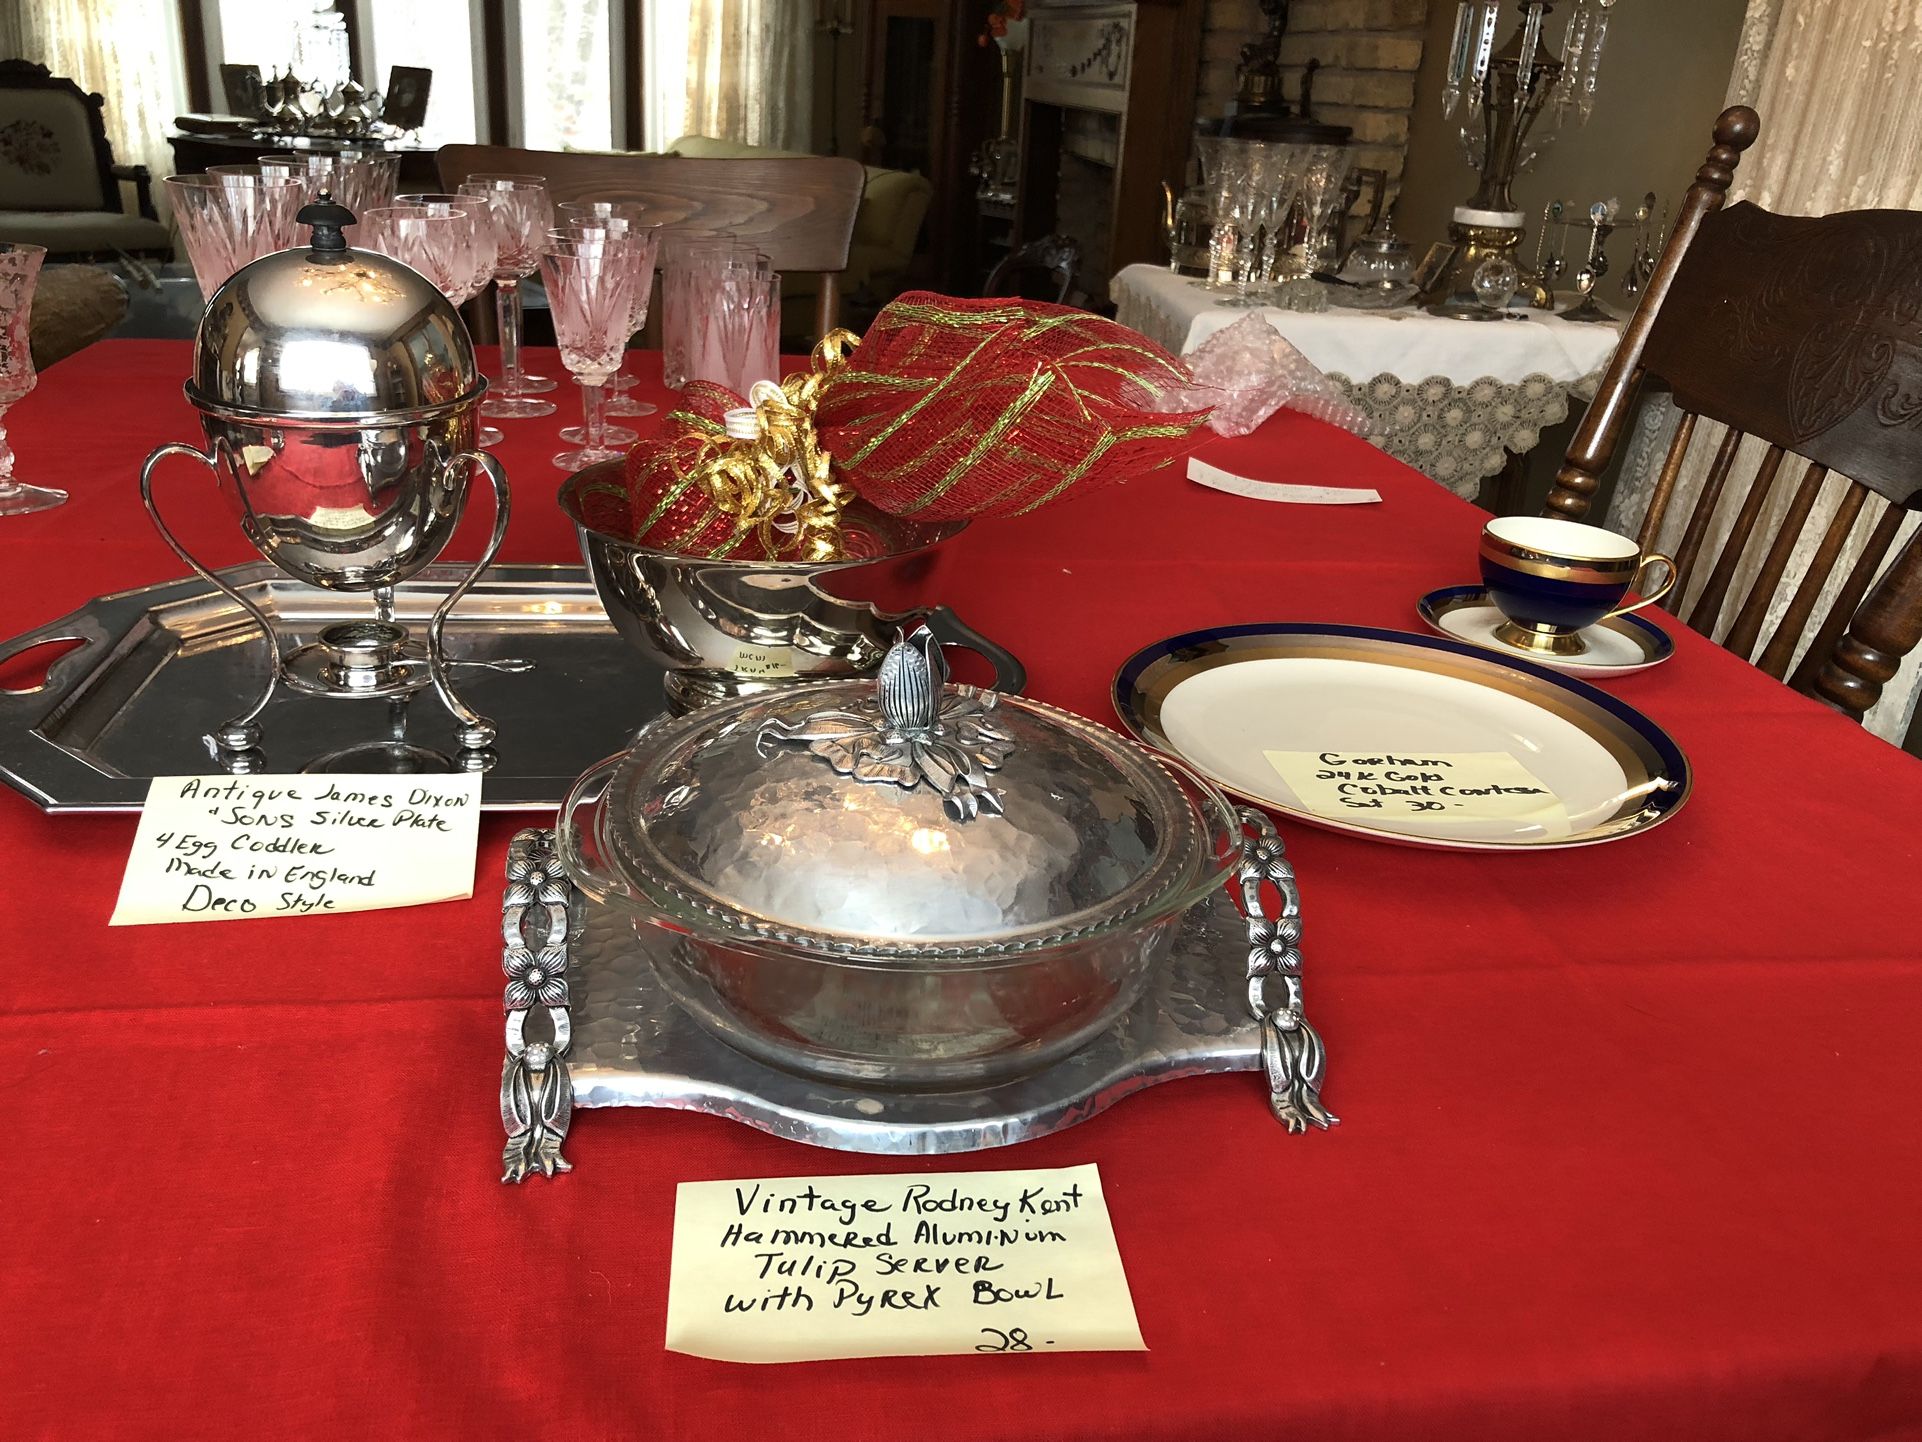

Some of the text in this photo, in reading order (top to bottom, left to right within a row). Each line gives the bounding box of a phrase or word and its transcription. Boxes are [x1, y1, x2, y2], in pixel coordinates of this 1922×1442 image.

[1337, 783, 1434, 796] Cobalt
[1384, 771, 1445, 783] Gold
[180, 778, 303, 810] Antique
[314, 783, 393, 808] James
[392, 808, 453, 832] Plate
[156, 832, 175, 850] 4
[175, 834, 218, 859] Egg
[165, 857, 238, 880] Made
[284, 865, 376, 890] England
[182, 884, 336, 913] Deco Style
[735, 1183, 1083, 1226] Vintage Rodney Kent
[754, 1252, 857, 1284] Tulip
[724, 1284, 814, 1313] with
